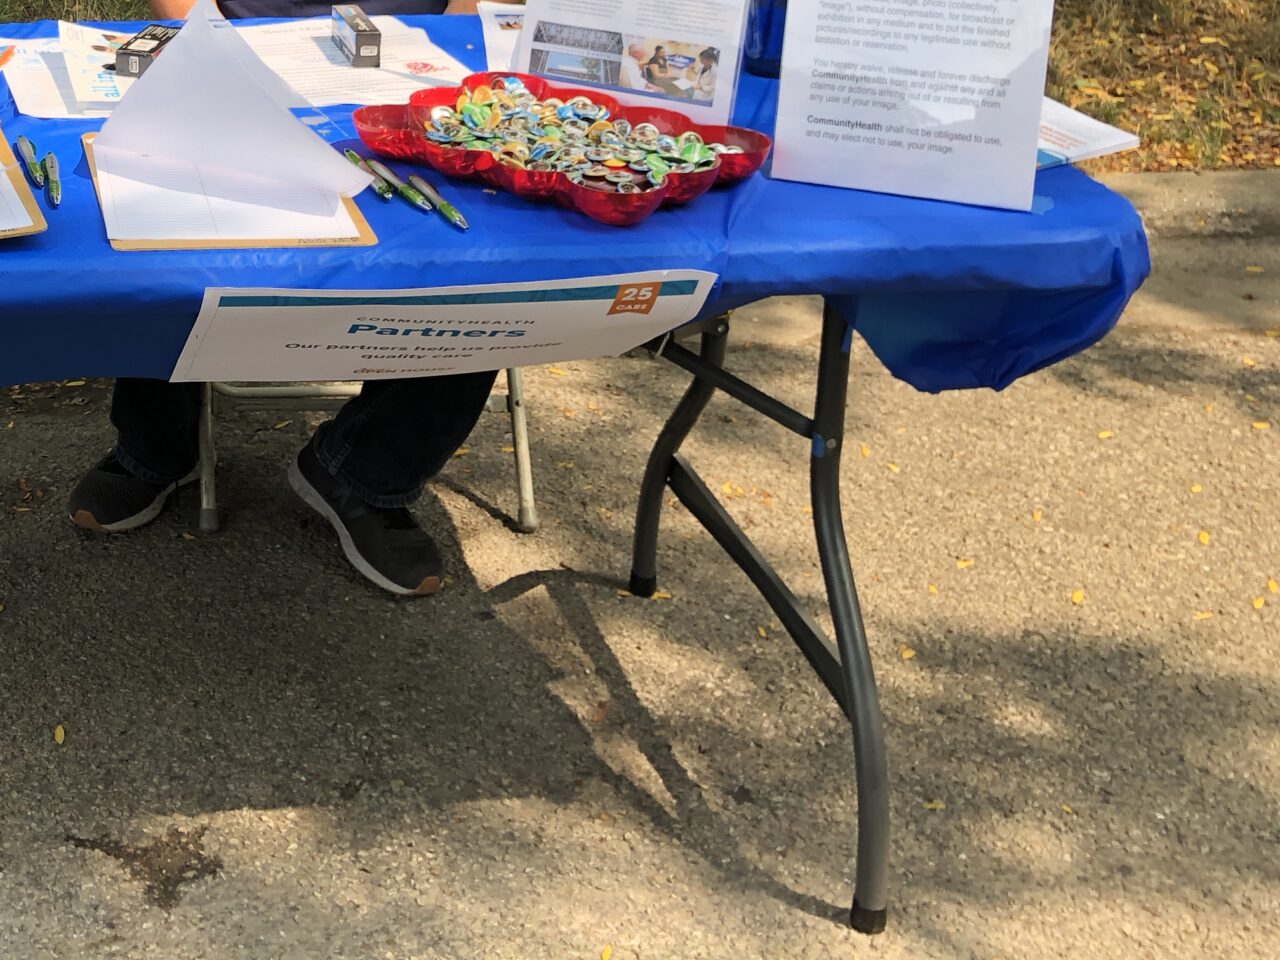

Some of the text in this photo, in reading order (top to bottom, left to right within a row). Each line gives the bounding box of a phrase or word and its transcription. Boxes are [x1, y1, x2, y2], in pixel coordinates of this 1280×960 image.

[856, 4, 884, 13] without
[887, 7, 946, 21] compensation,
[948, 12, 959, 20] for
[961, 13, 1003, 24] broadcast
[817, 12, 854, 22] exhibition
[866, 18, 880, 27] any
[883, 18, 915, 28] medium
[918, 21, 933, 30] and
[935, 23, 943, 31] to
[945, 24, 959, 34] put
[961, 25, 974, 33] the
[977, 27, 1010, 37] finished
[862, 40, 908, 51] reservation.
[893, 31, 901, 39] to
[903, 33, 918, 42] any
[920, 33, 960, 46] legitimate
[980, 39, 1011, 49] without
[813, 58, 828, 67] You
[920, 69, 935, 77] and
[937, 70, 967, 81] forever
[969, 74, 1010, 87] discharge
[811, 69, 887, 86] CommunityHealth
[889, 77, 908, 87] from
[910, 79, 925, 88] and
[959, 86, 975, 95] any
[977, 86, 994, 95] and
[996, 88, 1005, 97] all
[809, 94, 823, 103] any
[842, 96, 849, 104] of
[851, 99, 869, 108] your
[810, 81, 835, 91] claims
[848, 85, 876, 95] actions
[907, 91, 920, 100] out
[922, 93, 930, 101] of
[943, 95, 979, 108] resulting
[981, 99, 1000, 108] from
[807, 115, 1002, 146] CommunityHealth shall not be obligated to use,
[805, 129, 820, 138] and
[822, 132, 839, 142] may
[841, 133, 860, 142] elect
[862, 135, 875, 144] not
[877, 137, 885, 145] to
[887, 139, 904, 148] use,
[906, 142, 924, 152] your
[621, 287, 653, 301] 25
[357, 317, 536, 325] COMMUNITYHEALTH
[347, 324, 526, 338] Partners
[326, 344, 408, 352] partners
[488, 341, 563, 352] provide
